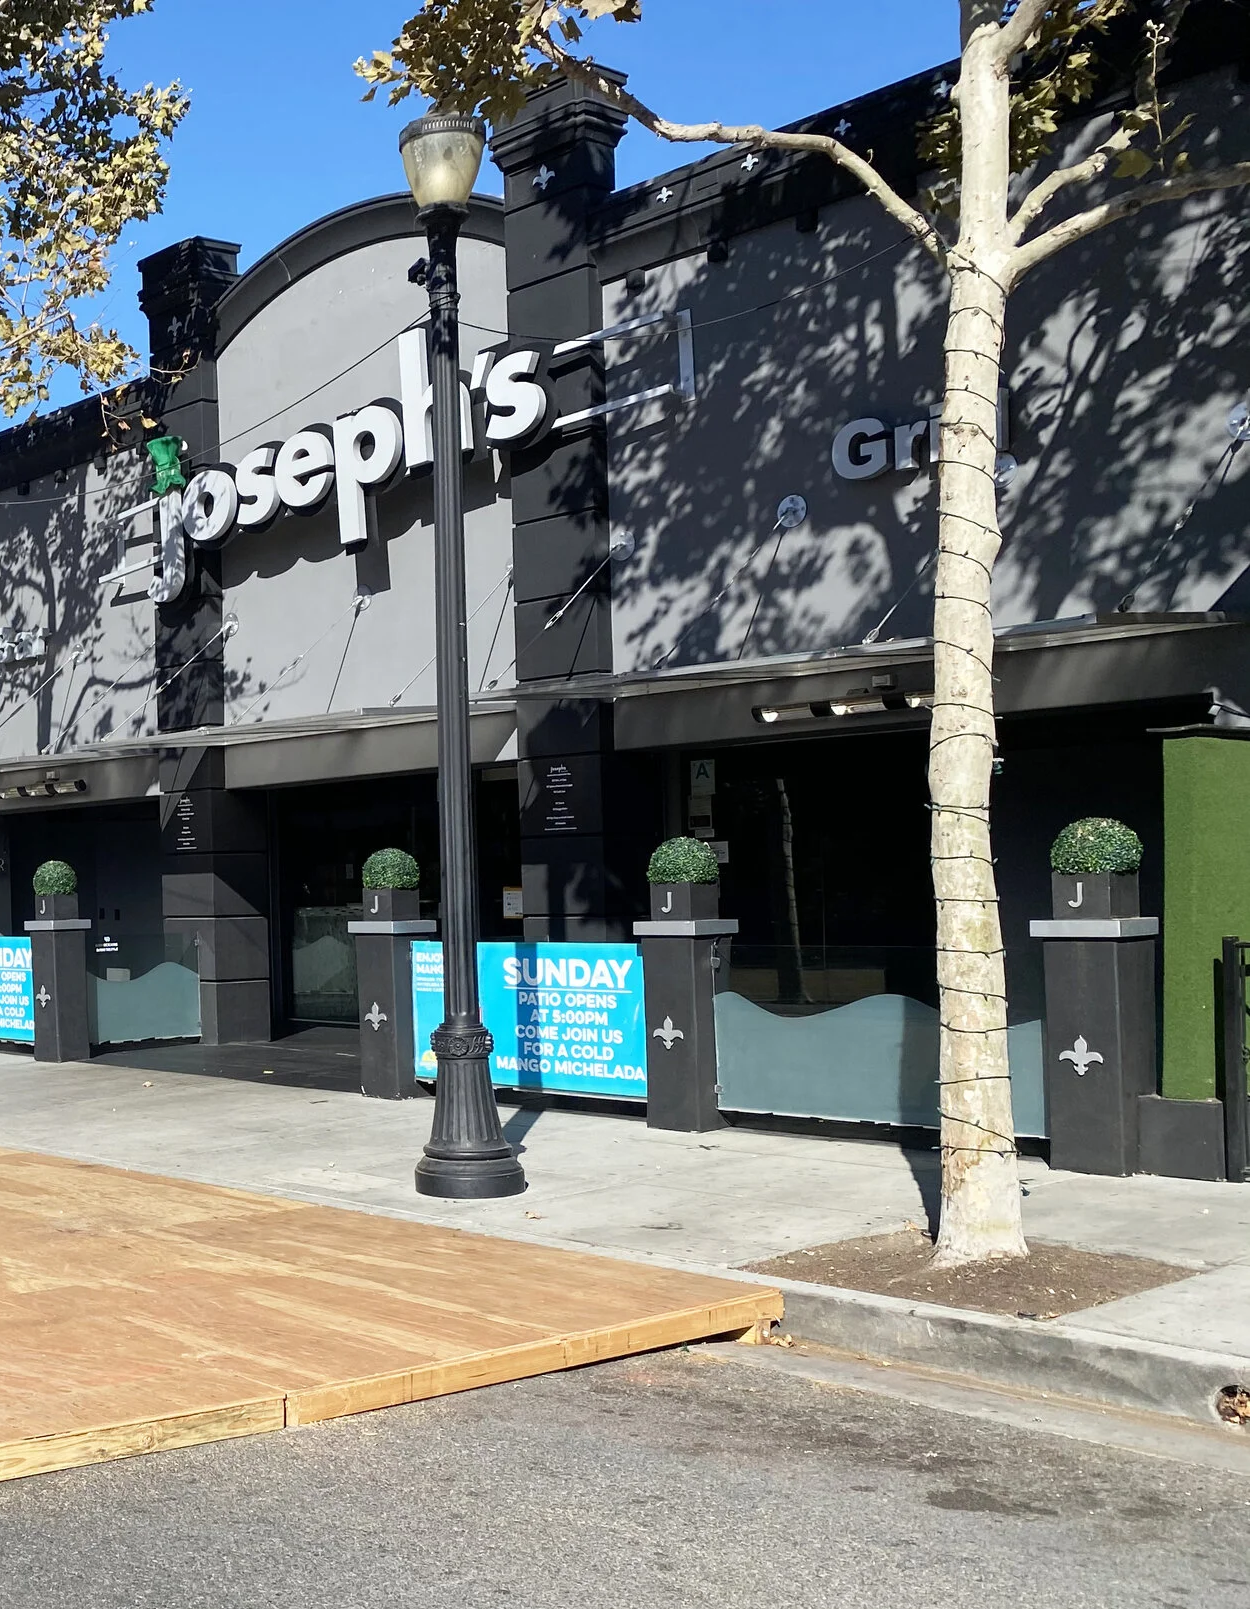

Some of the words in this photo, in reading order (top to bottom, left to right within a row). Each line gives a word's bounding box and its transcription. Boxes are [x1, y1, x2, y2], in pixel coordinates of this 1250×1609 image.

[832, 388, 1008, 480] Gri
[661, 891, 672, 913] J
[1068, 882, 1083, 908] J
[40, 900, 46, 914] J
[370, 895, 379, 914] J
[1, 971, 26, 982] OPENS
[503, 957, 633, 989] SUNDAY
[0, 995, 18, 1005] JOIN
[19, 996, 29, 1006] US
[518, 992, 561, 1006] PATIO
[564, 994, 617, 1009] OPENS
[4, 1007, 25, 1017] COLD
[530, 1009, 549, 1022] AT
[552, 1010, 609, 1026] 5:00PM
[515, 1025, 559, 1040] COME
[561, 1028, 598, 1042] JOIN
[601, 1030, 624, 1044] US
[524, 1042, 554, 1057] FOR
[557, 1044, 569, 1058] A
[570, 1045, 614, 1060] COLD
[496, 1056, 551, 1073] MANGO
[554, 1060, 647, 1081] MICHELADA
